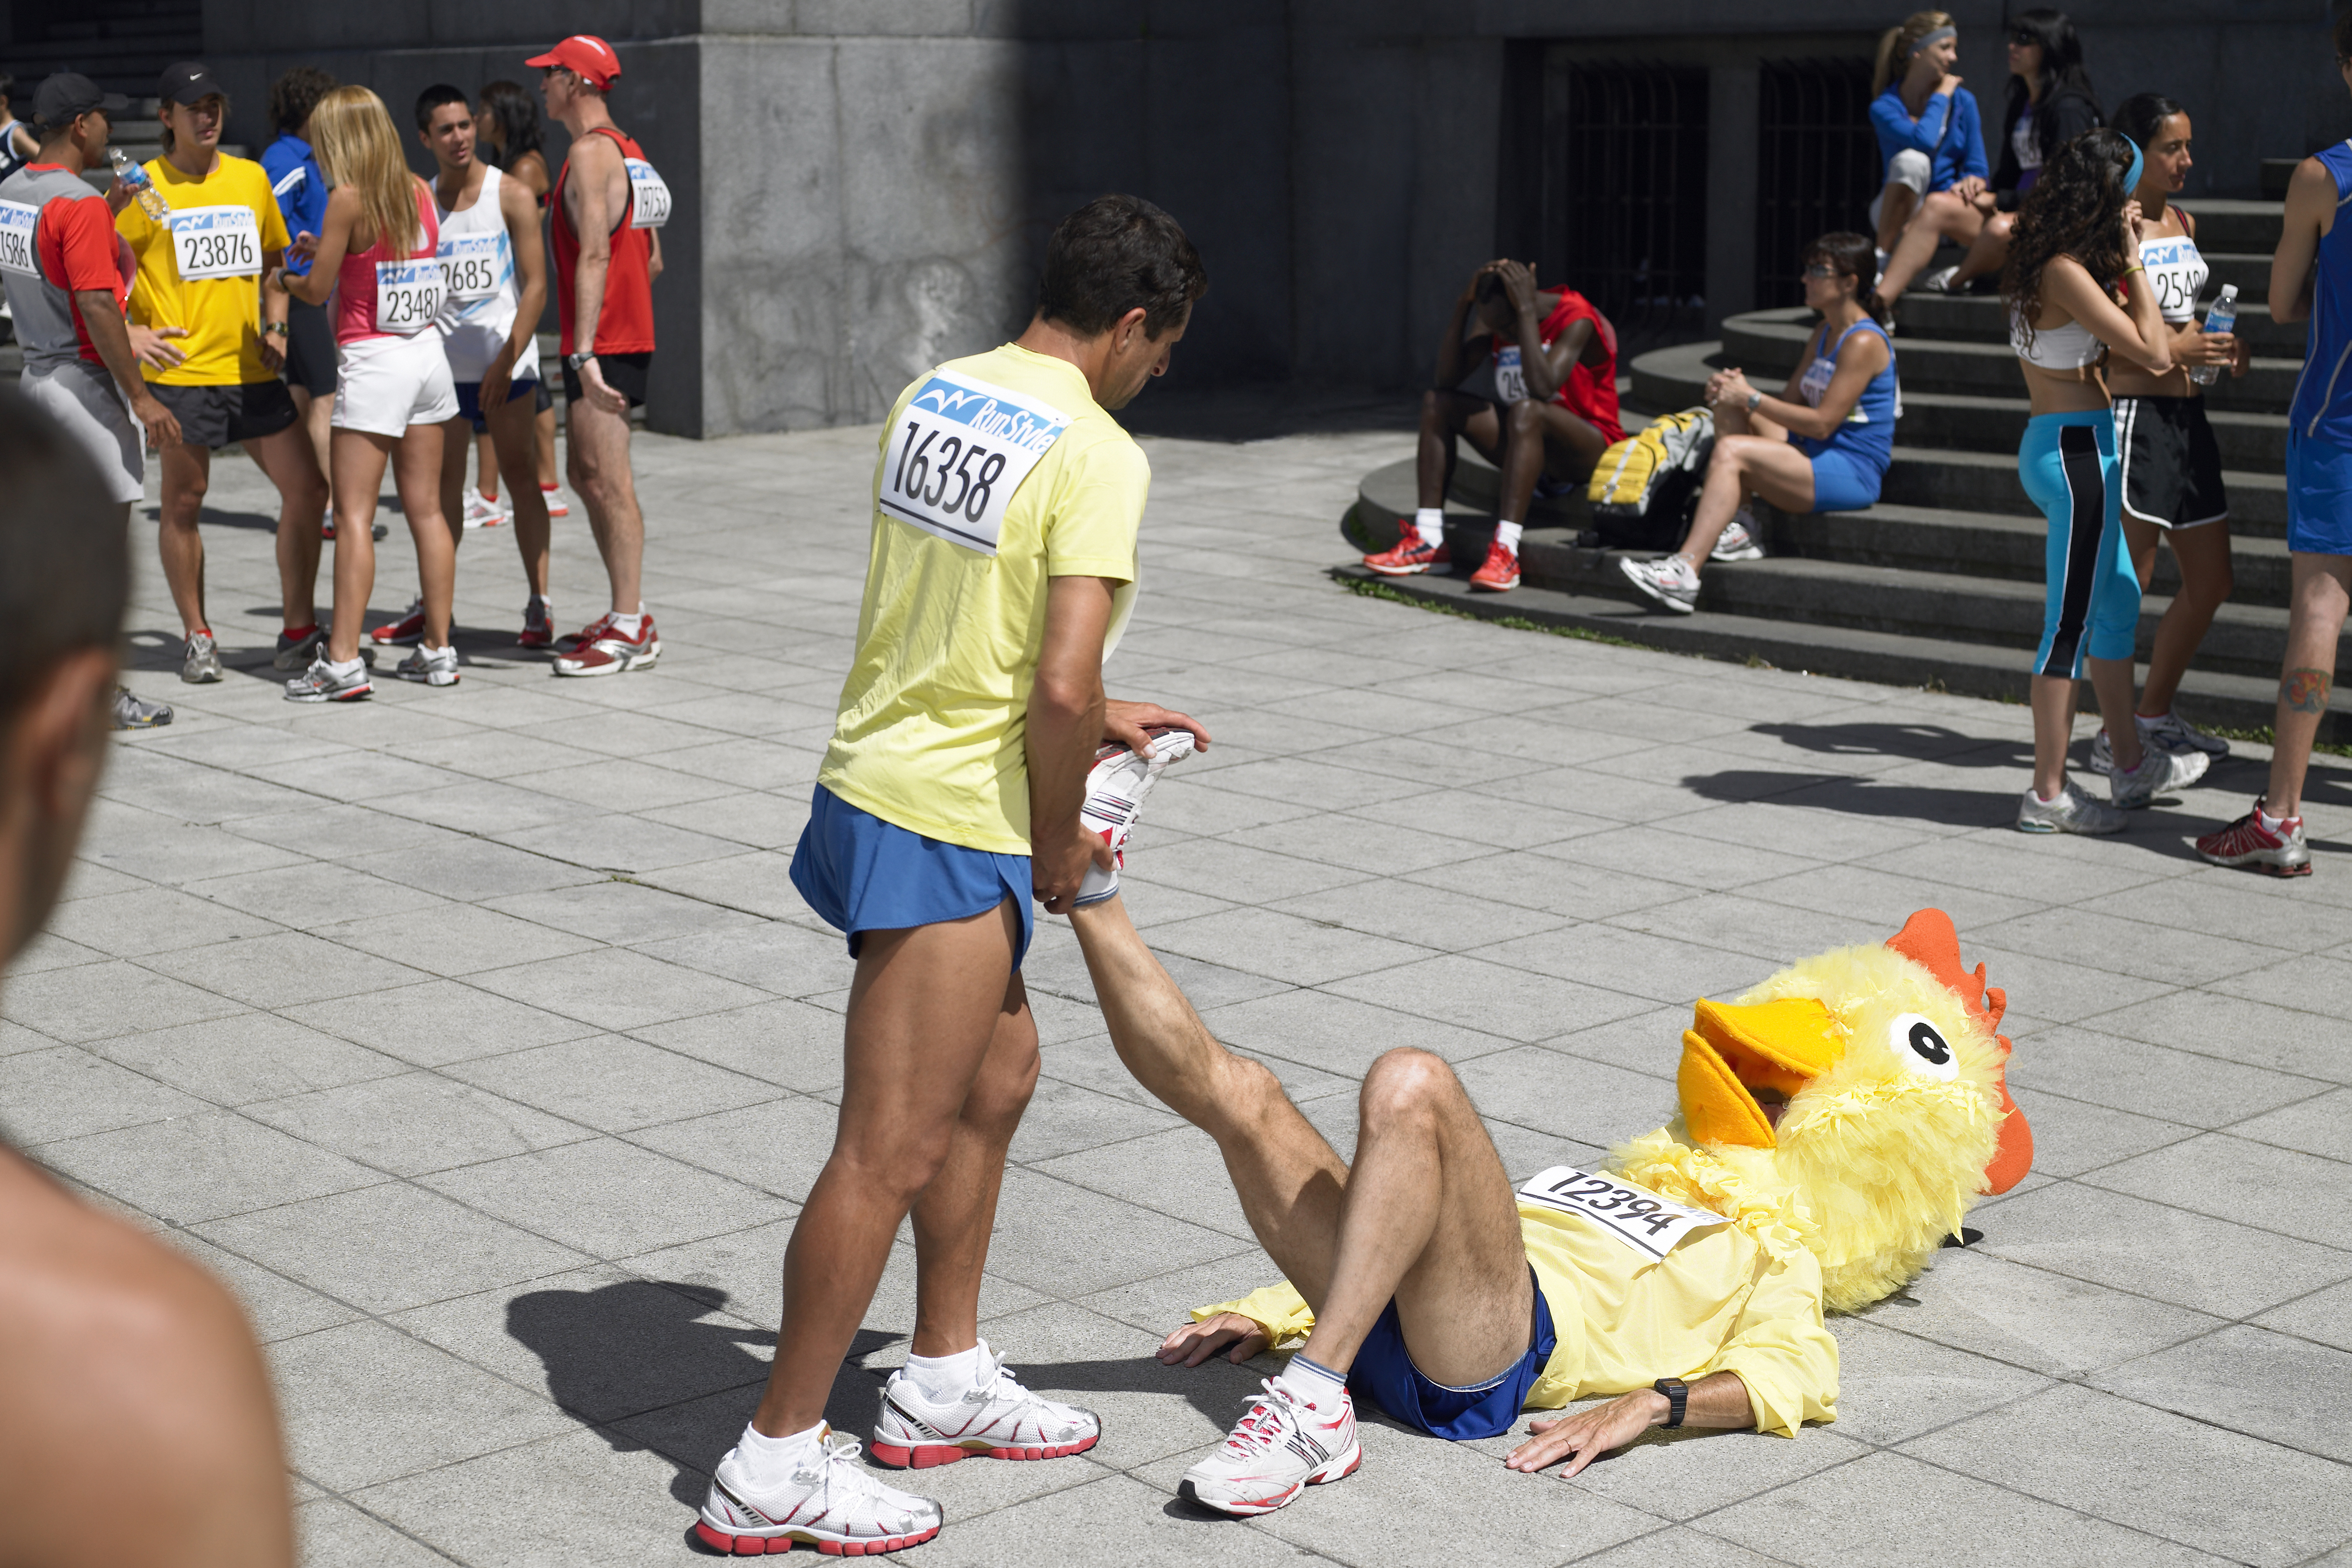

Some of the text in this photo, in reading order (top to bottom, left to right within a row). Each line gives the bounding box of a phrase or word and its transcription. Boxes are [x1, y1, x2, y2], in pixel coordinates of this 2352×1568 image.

[0, 231, 29, 267] 1586
[185, 234, 253, 269] 23876
[387, 287, 439, 322] 23481
[969, 398, 1057, 452] RunStyle
[894, 422, 1006, 523] 16358
[1547, 1172, 1688, 1237] 12394
